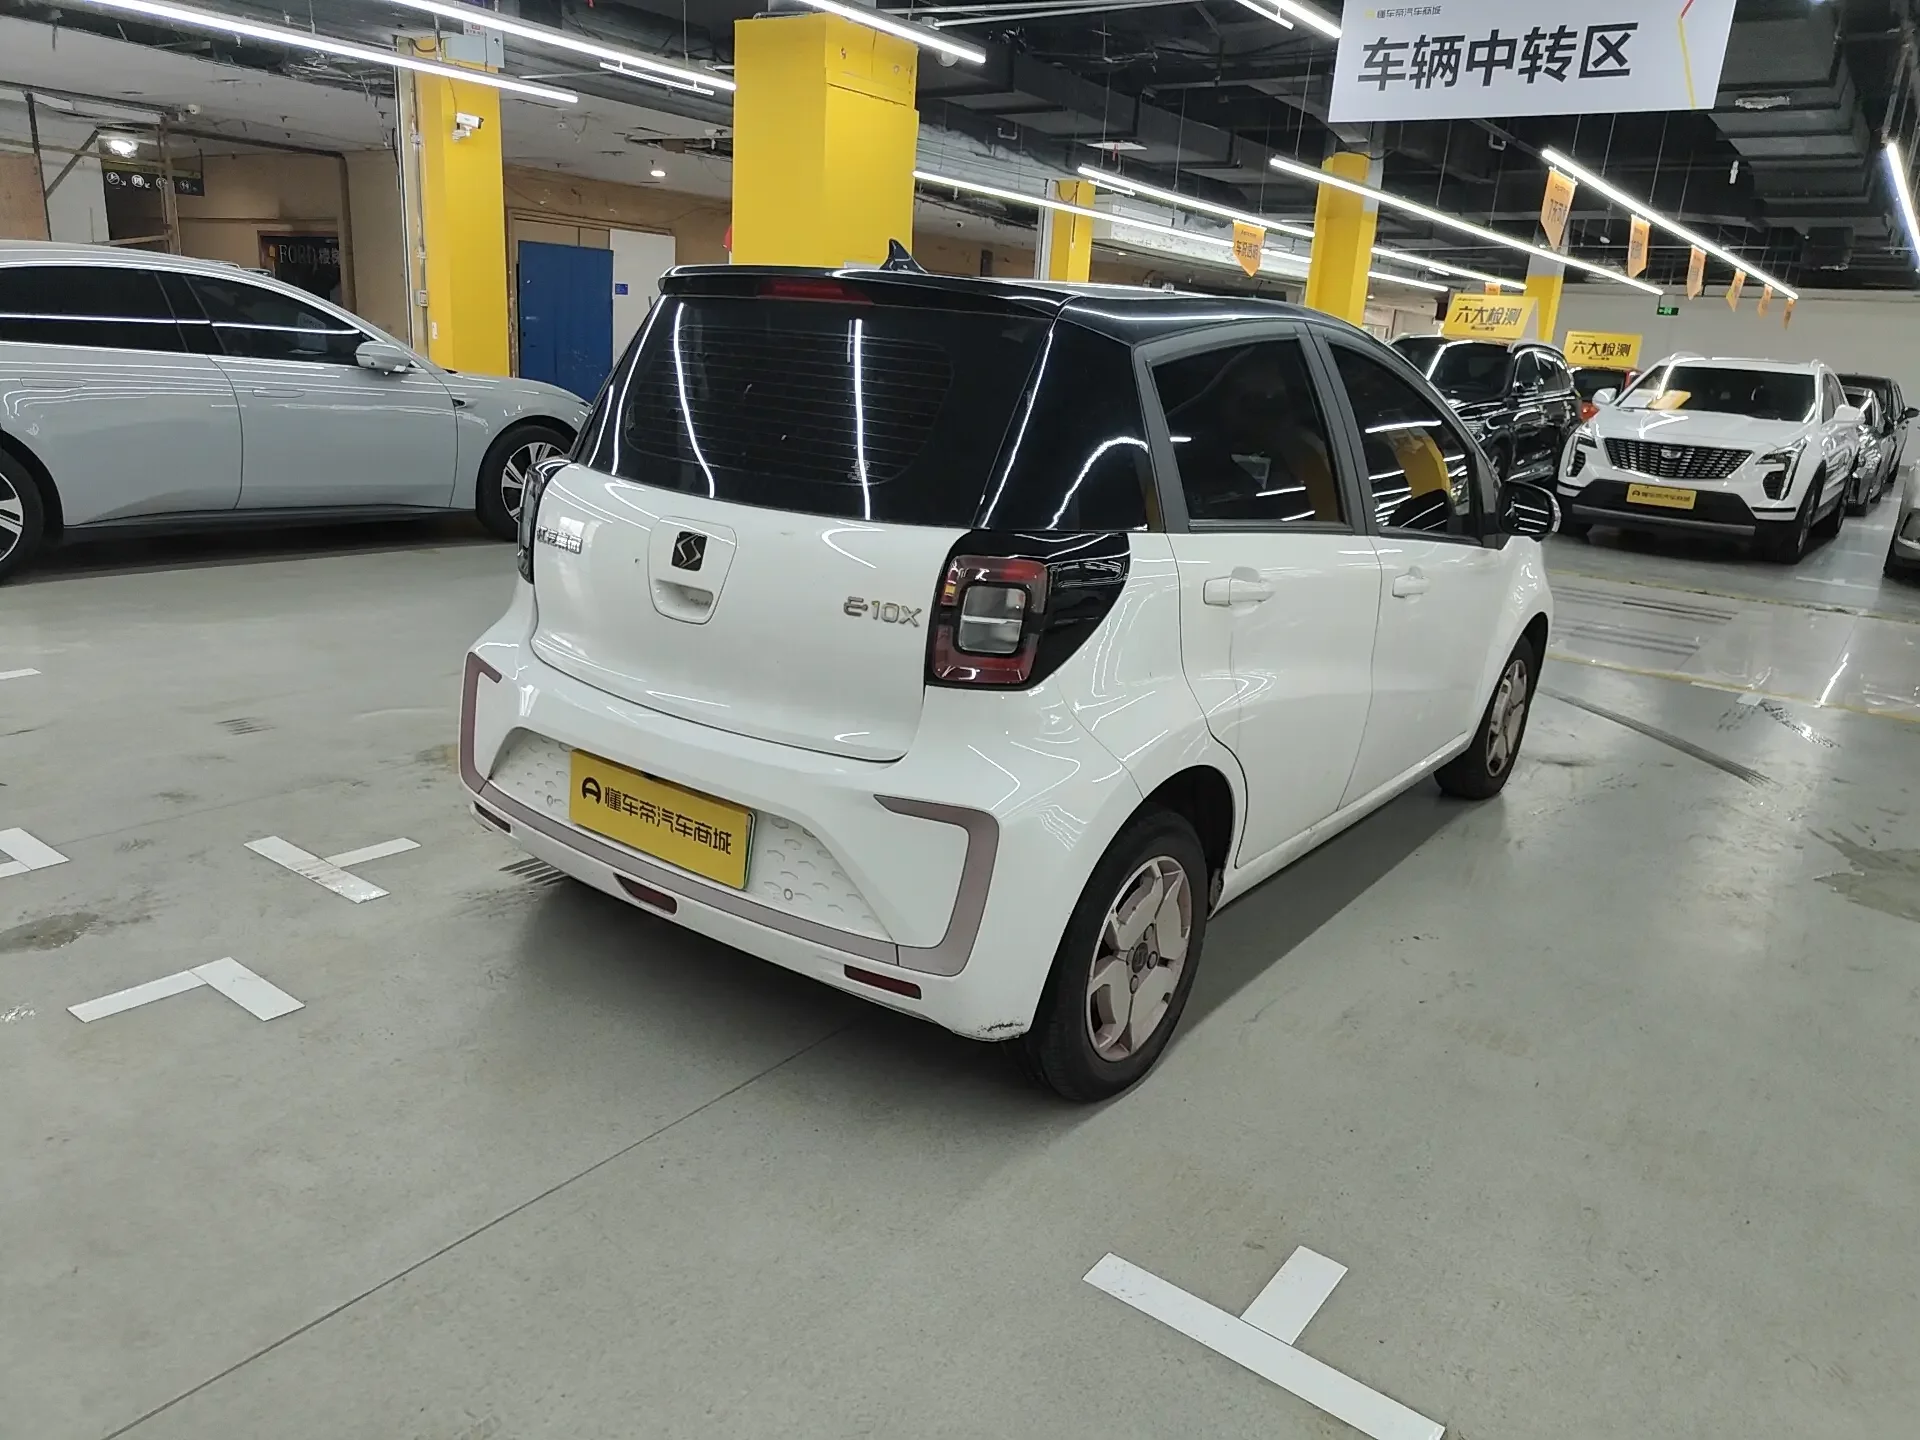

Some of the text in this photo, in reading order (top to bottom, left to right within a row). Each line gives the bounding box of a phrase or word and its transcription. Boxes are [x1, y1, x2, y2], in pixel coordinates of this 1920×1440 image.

[1357, 21, 1639, 92] 车辆中转区
[1454, 305, 1523, 326] 六大检测
[1571, 340, 1632, 358] 六大检测
[604, 786, 732, 855] 懂车帝汽车商城
